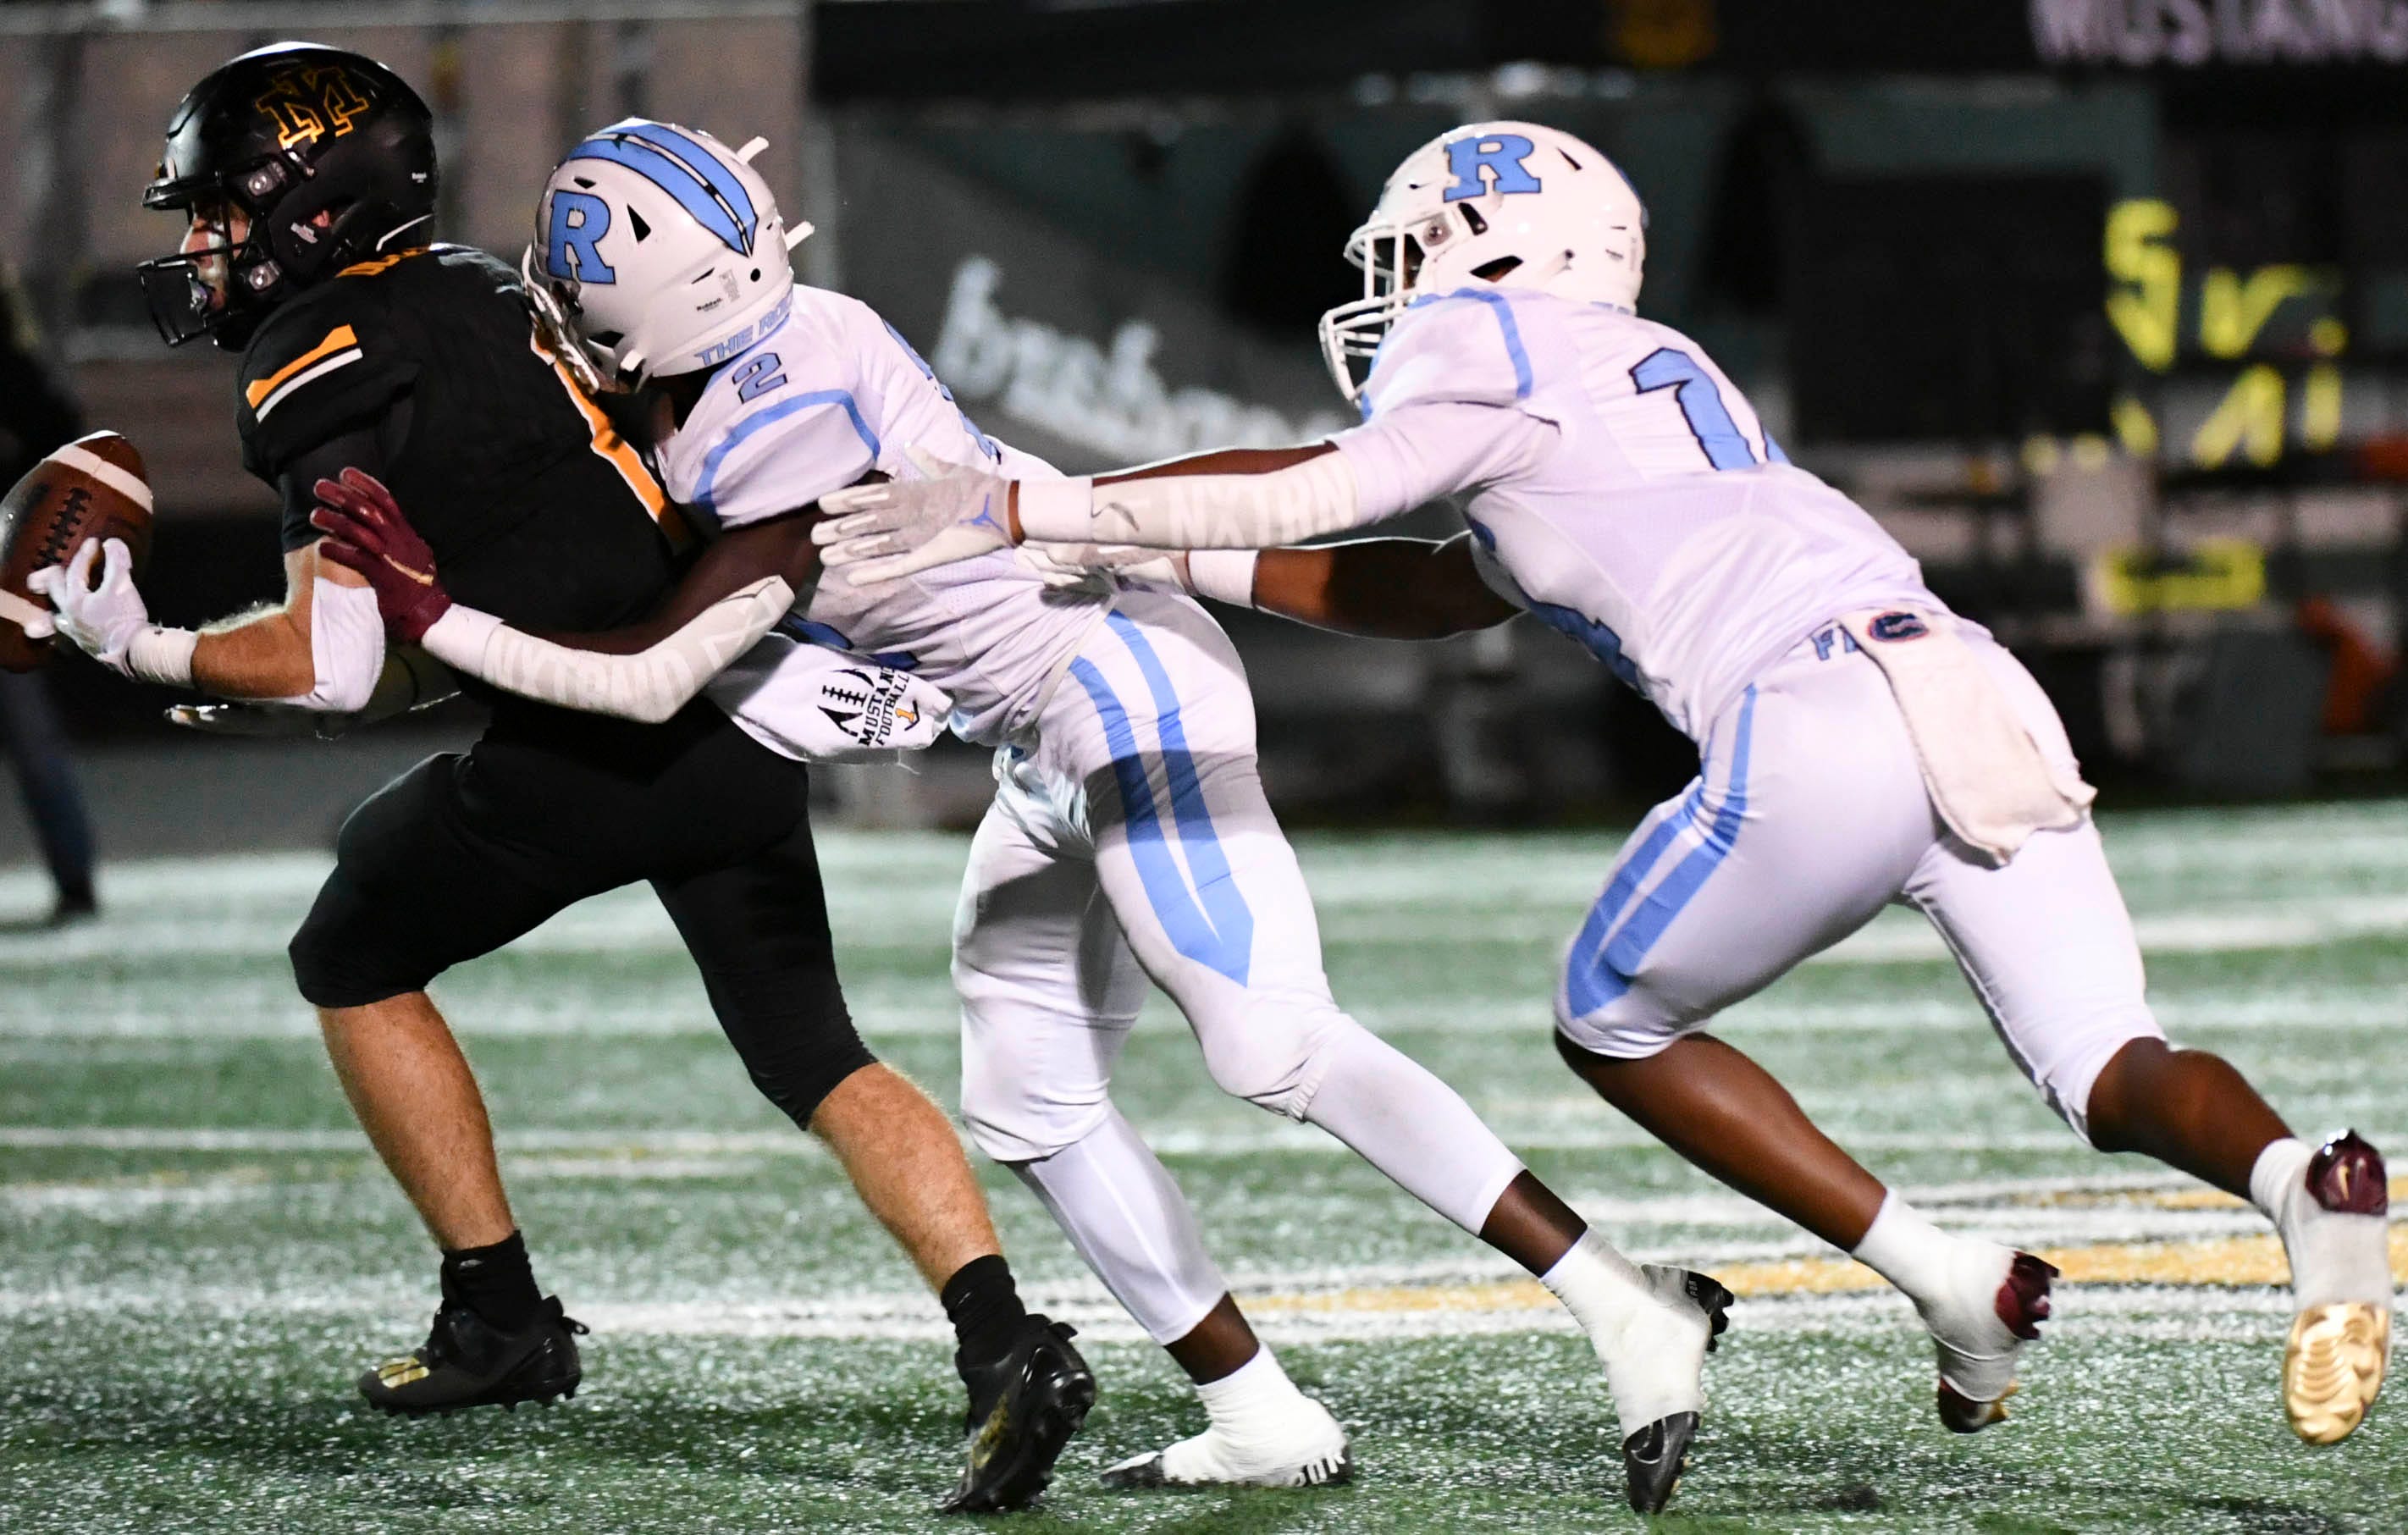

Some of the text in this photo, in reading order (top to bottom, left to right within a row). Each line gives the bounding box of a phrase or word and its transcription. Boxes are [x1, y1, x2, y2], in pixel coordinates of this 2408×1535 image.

[1443, 134, 1542, 203] R
[546, 188, 616, 285] R
[694, 325, 753, 367] THE
[731, 352, 788, 405] 2
[875, 675, 909, 746] FOOTBALL
